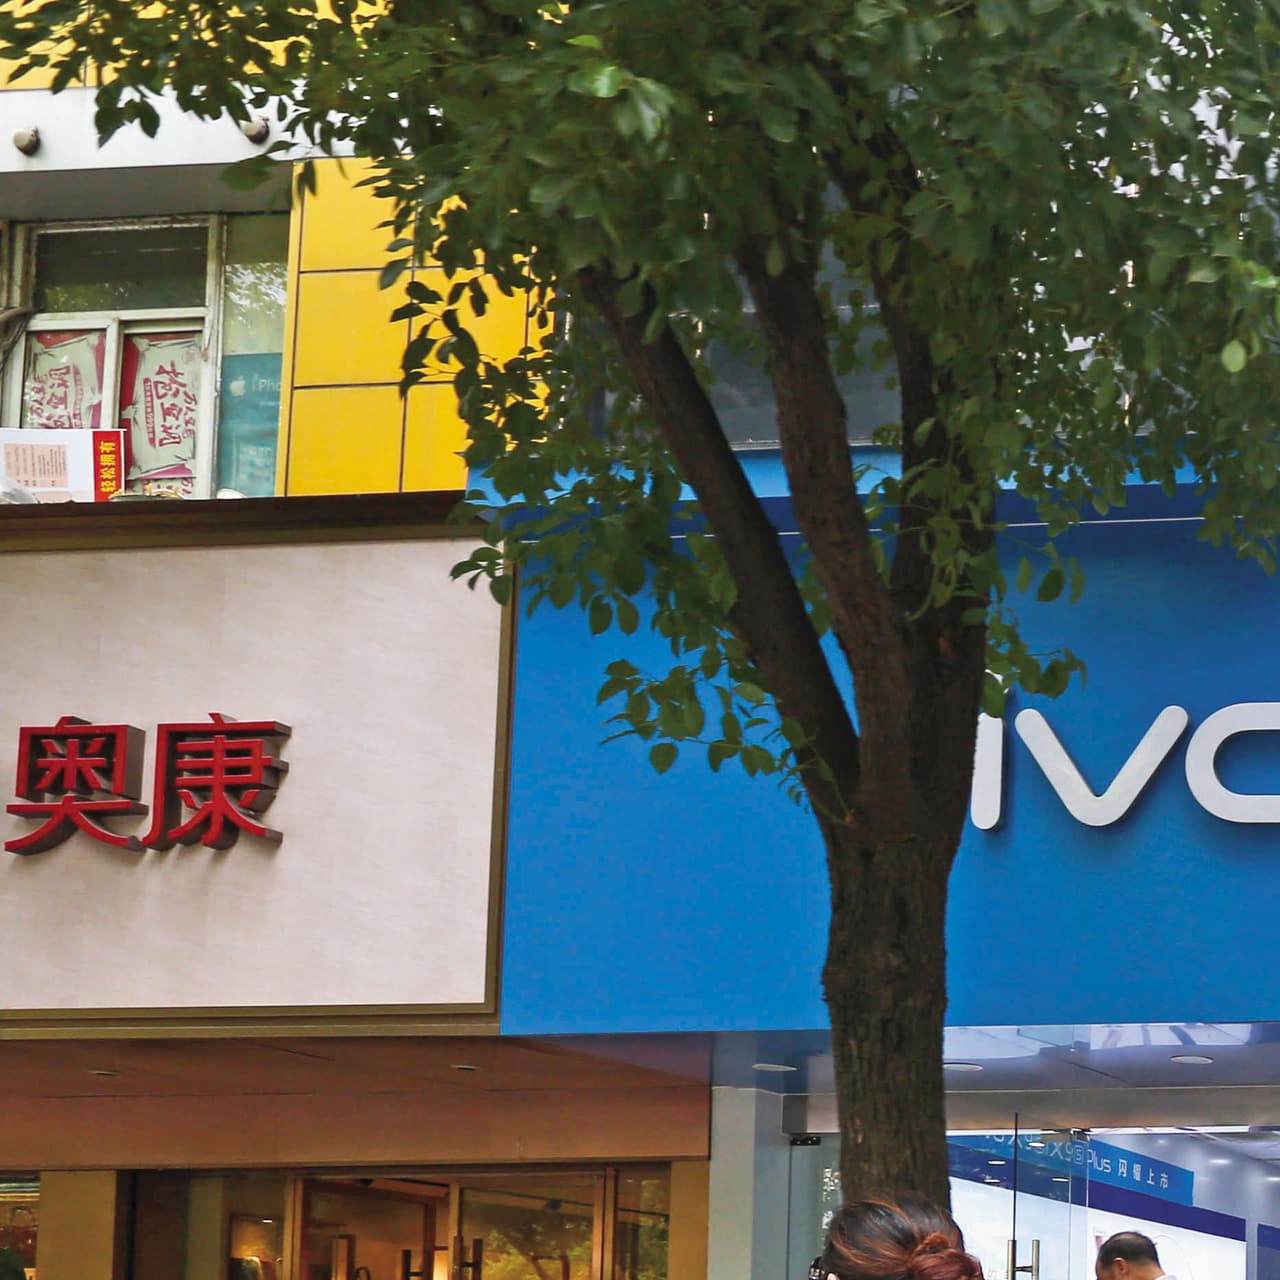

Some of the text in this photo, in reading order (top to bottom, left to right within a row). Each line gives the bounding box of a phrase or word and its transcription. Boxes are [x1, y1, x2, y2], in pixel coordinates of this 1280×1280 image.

[100, 441, 116, 493] 轻松拥有
[4, 713, 291, 856] 奥康
